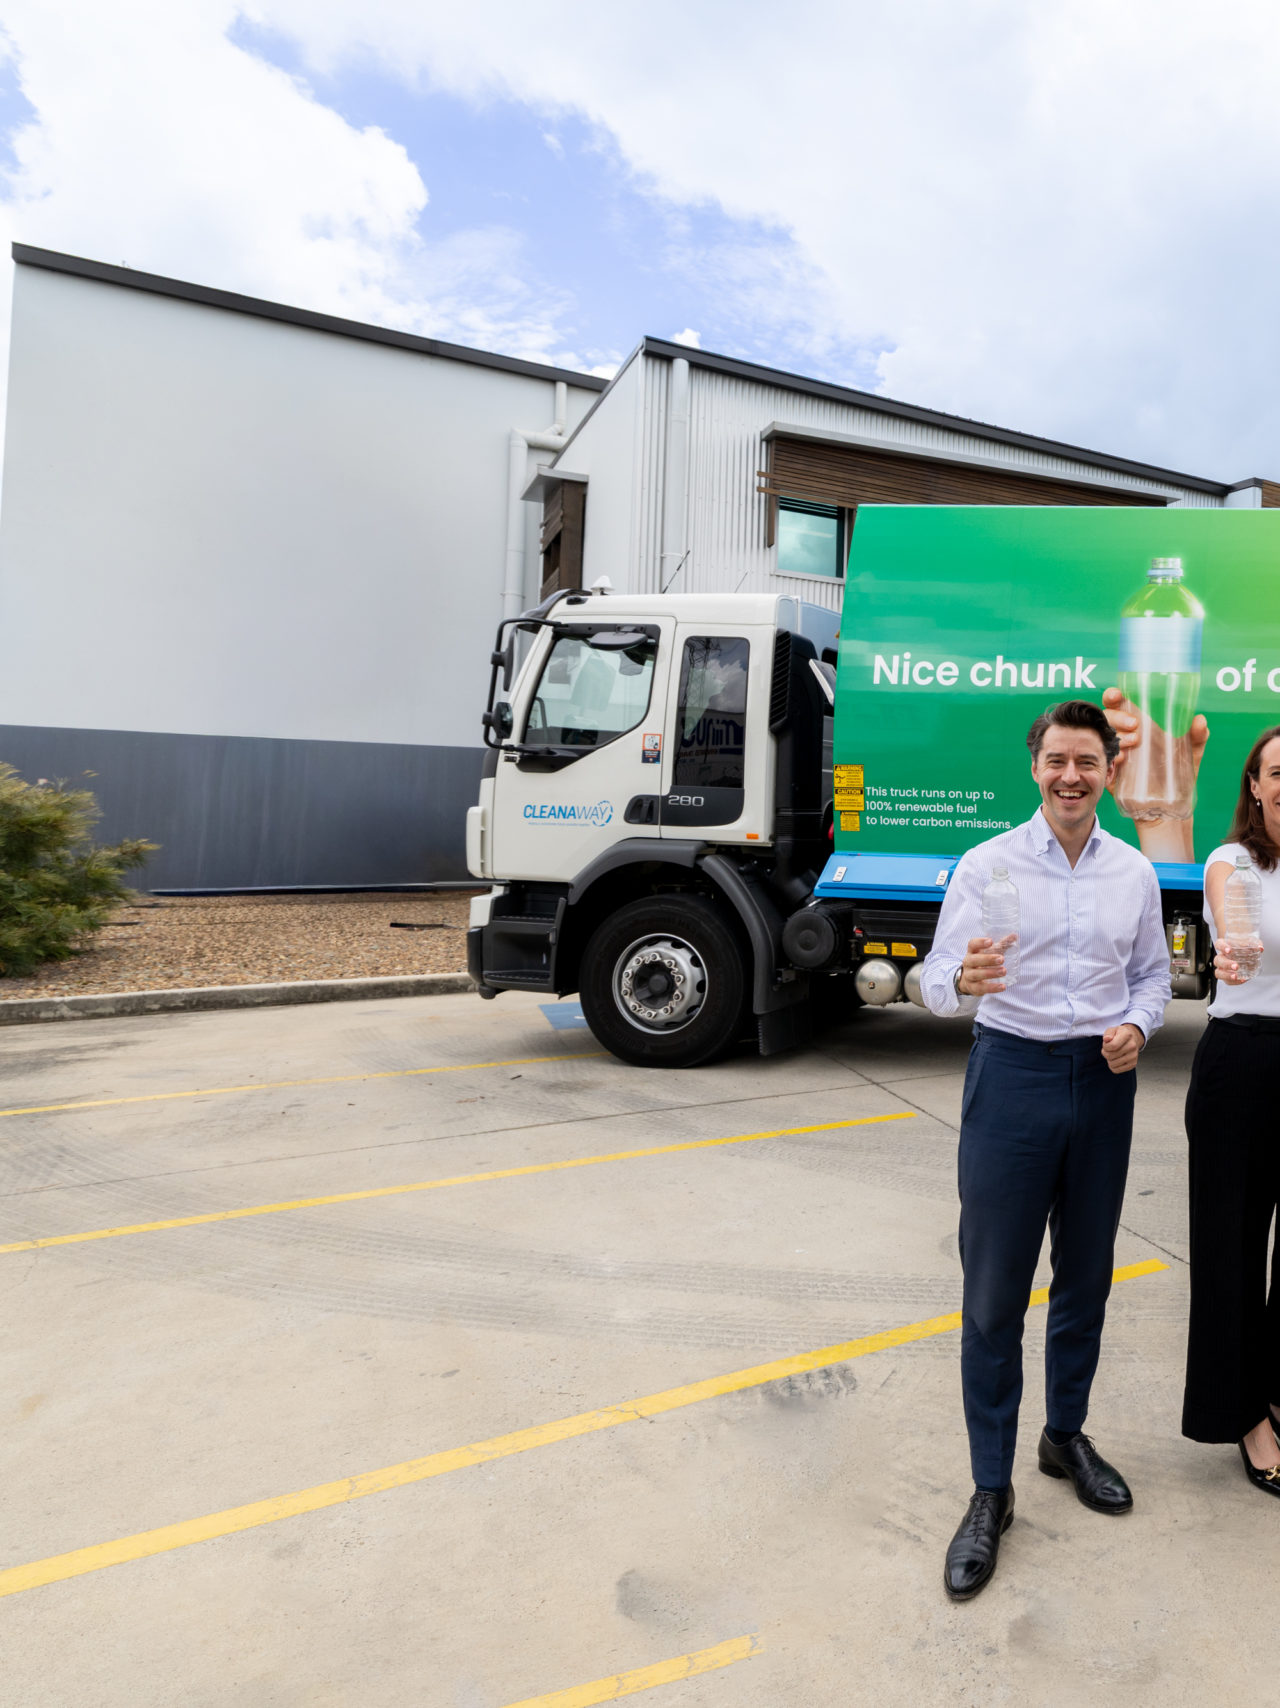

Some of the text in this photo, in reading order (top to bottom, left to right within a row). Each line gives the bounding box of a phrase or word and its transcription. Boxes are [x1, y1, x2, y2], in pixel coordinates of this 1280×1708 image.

[873, 651, 1098, 689] Nice chunk
[1216, 658, 1257, 692] of
[668, 795, 704, 807] 280
[865, 786, 995, 801] This truck runs on up to
[523, 804, 609, 820] CLEANAWAY
[865, 801, 893, 811] 100%
[895, 802, 954, 813] renewable
[956, 803, 977, 813] fuel
[866, 815, 877, 825] to
[880, 816, 910, 826] lower
[912, 817, 952, 827] carbon
[955, 818, 1014, 829] emissions.
